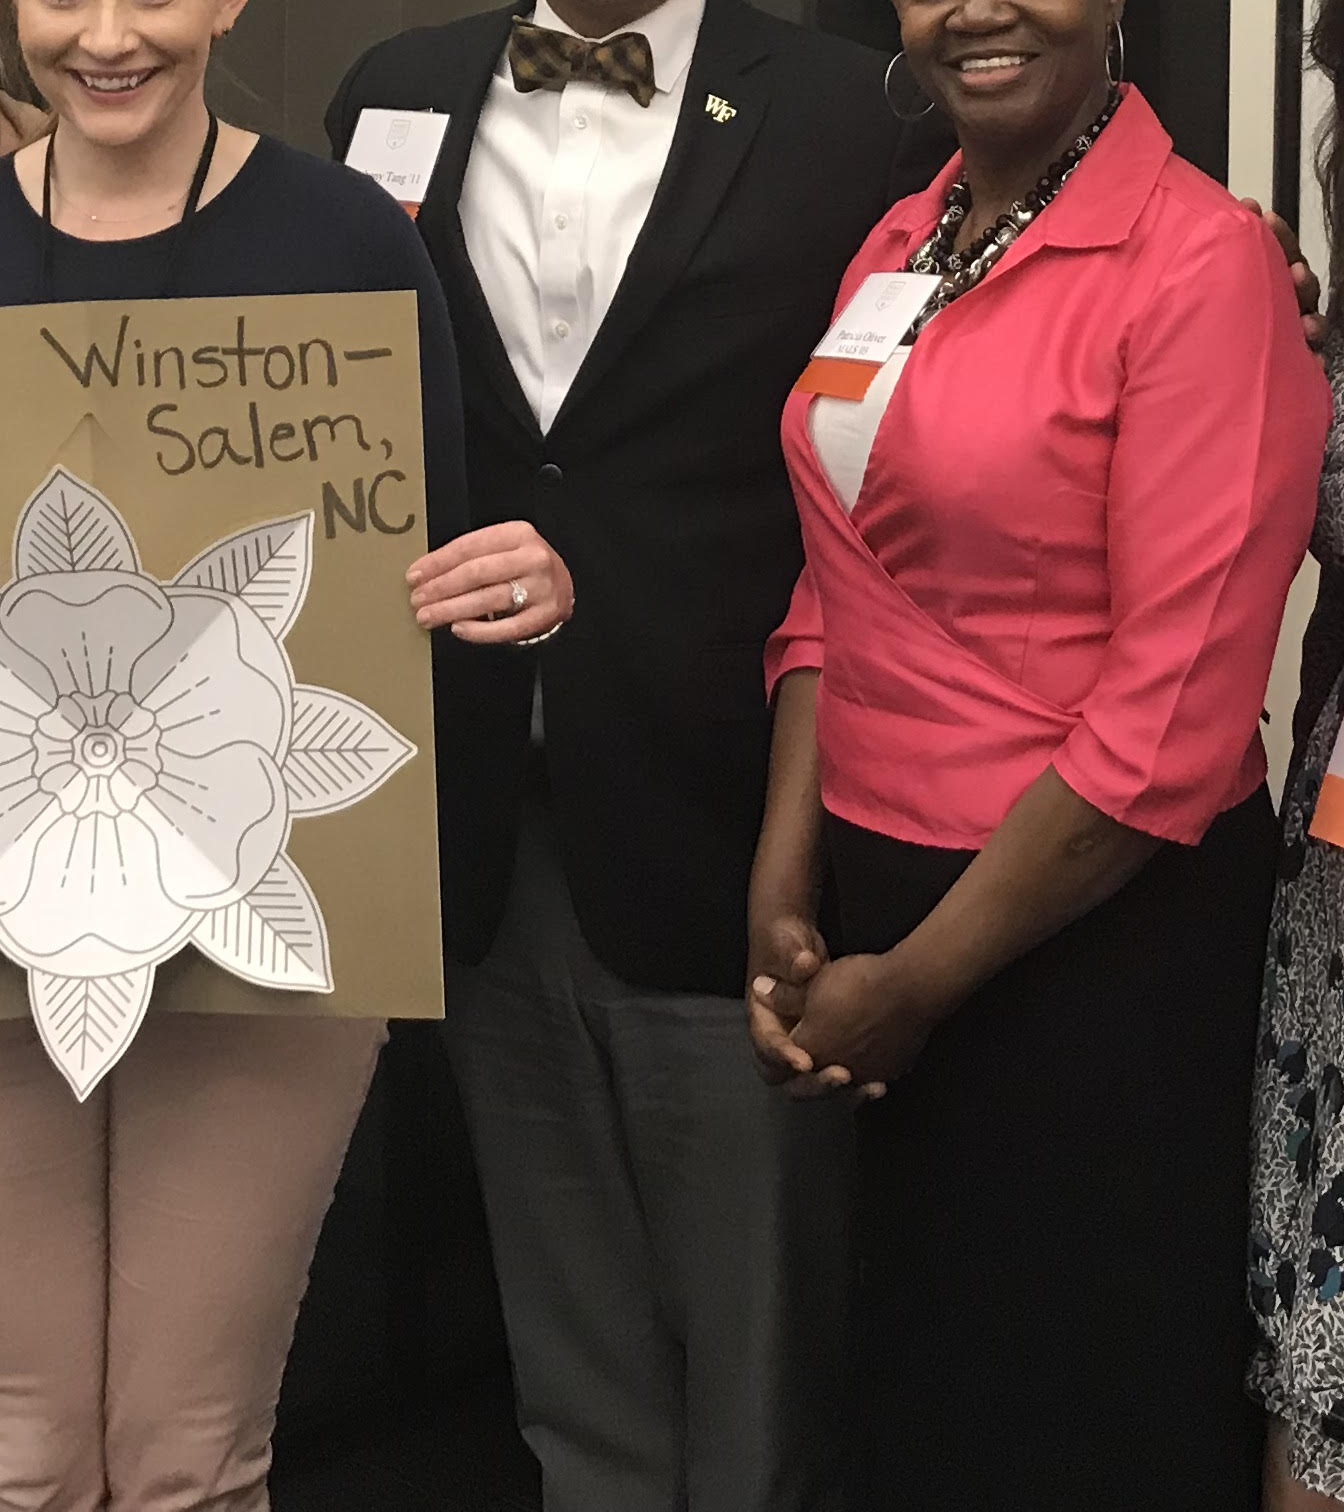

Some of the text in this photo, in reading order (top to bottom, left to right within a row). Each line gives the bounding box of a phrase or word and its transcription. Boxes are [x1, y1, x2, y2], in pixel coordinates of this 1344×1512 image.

[39, 315, 393, 390] Winston-
[146, 401, 394, 476] Salem,
[321, 469, 416, 540] NC
